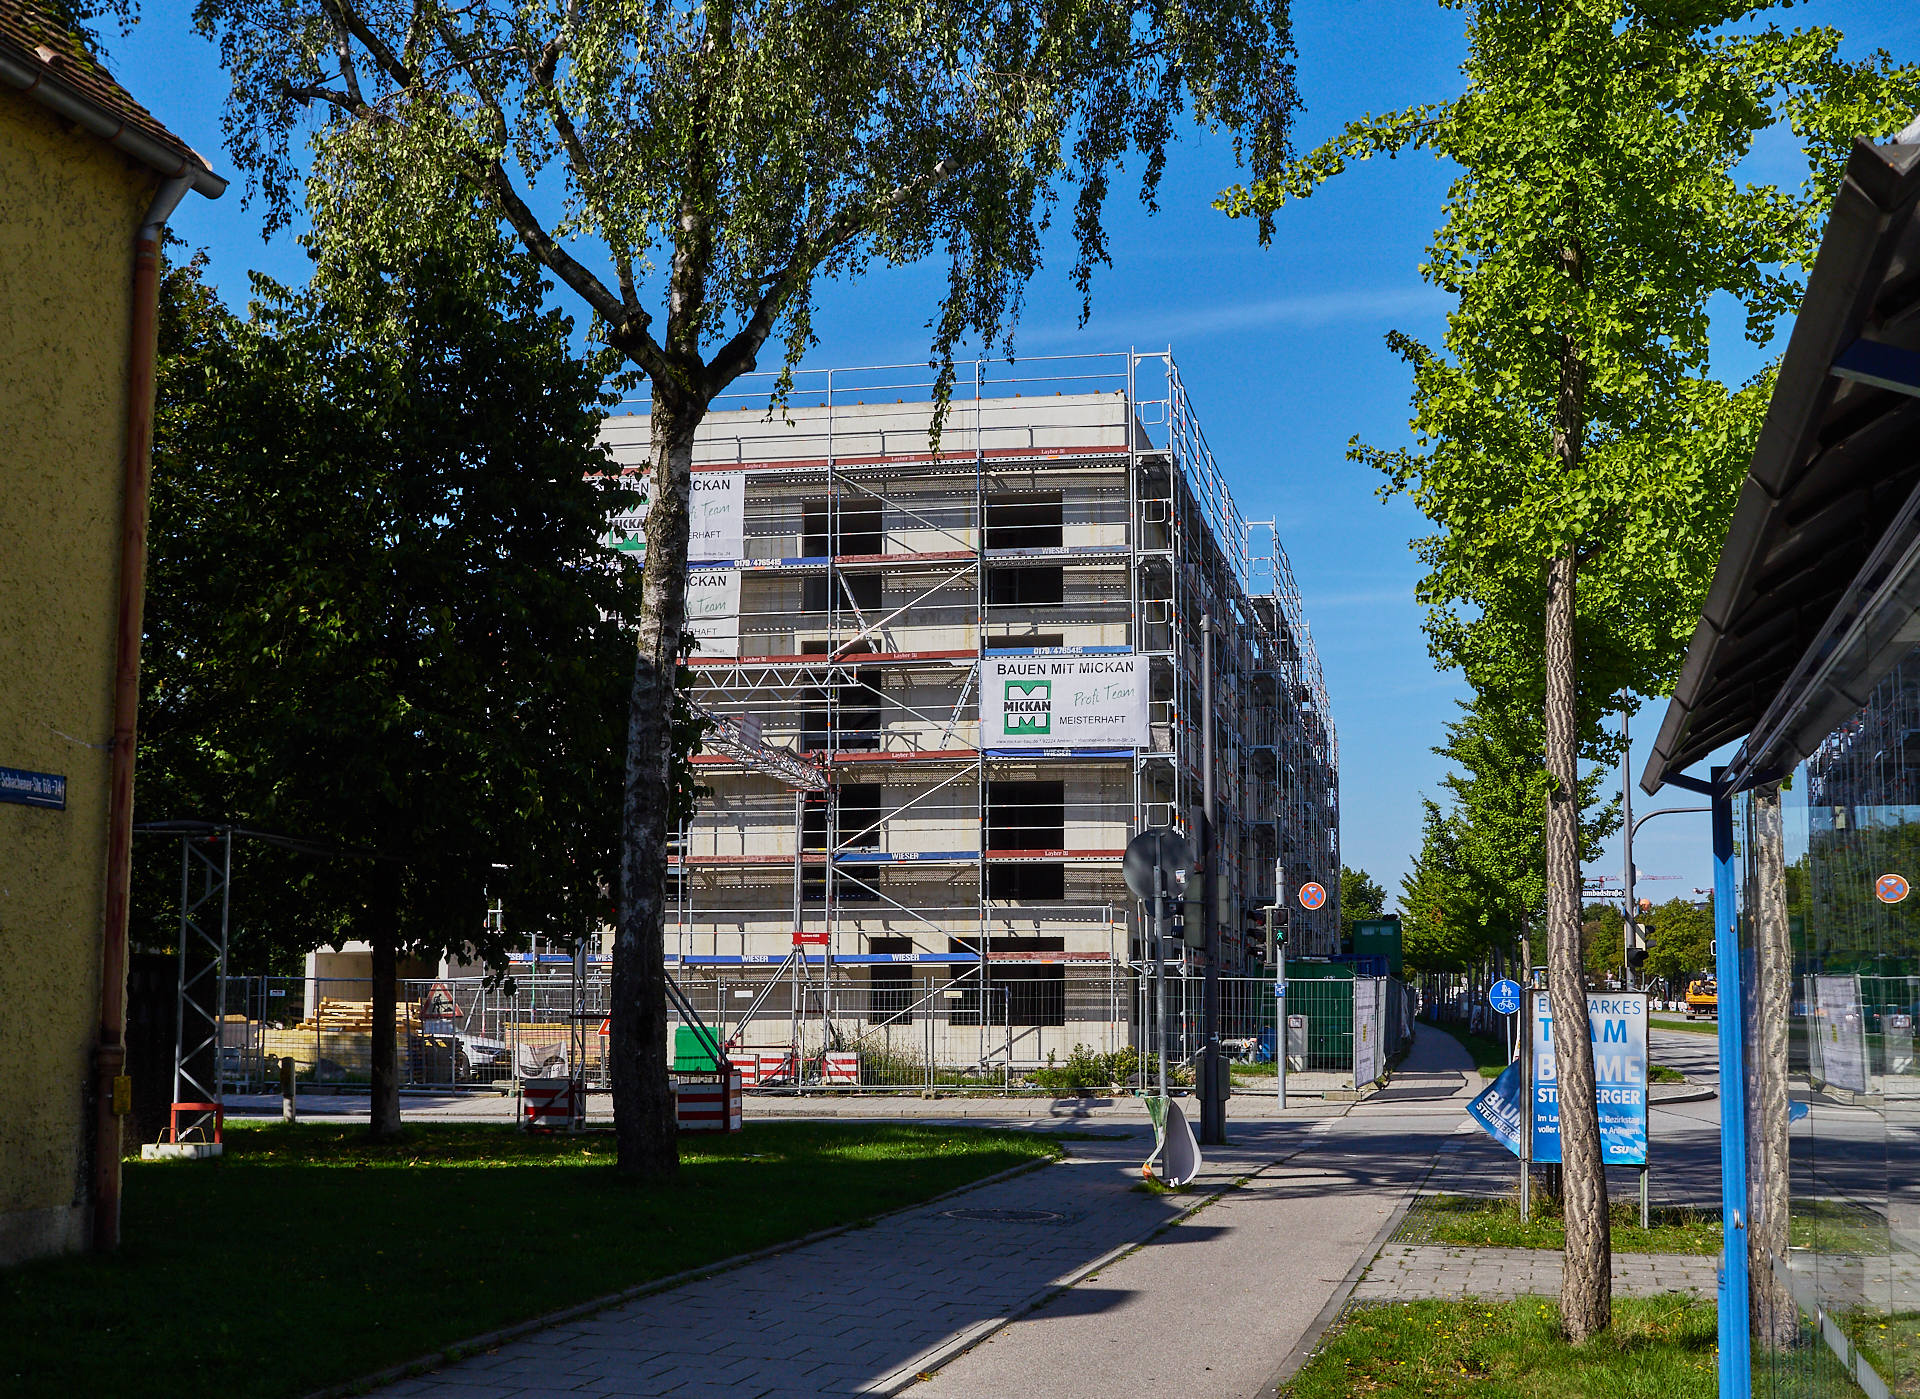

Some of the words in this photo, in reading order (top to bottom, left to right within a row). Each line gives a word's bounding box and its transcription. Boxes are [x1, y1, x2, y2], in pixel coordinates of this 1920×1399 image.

[689, 479, 731, 491] ICKAN
[701, 500, 730, 518] Team
[689, 530, 722, 540] ERHAFT
[1041, 546, 1070, 554] WIESER
[689, 575, 727, 587] CKAN
[697, 596, 727, 613] Team
[997, 663, 1046, 675] BAUEN
[1051, 663, 1074, 674] MIT
[1079, 661, 1134, 674] MICKAN
[1074, 689, 1100, 707] Profi
[1104, 683, 1135, 701] Team
[1004, 701, 1050, 712] MICKAN
[1059, 715, 1126, 725] MEISTERHAFT
[891, 852, 919, 860] WIESER
[1582, 889, 1623, 897] umbadstraße
[595, 954, 613, 962] WIES
[741, 955, 769, 963] WIESER
[891, 953, 920, 962] WIESER
[1538, 998, 1551, 1013] EI
[1587, 999, 1641, 1015] ARKES
[1538, 1017, 1627, 1043] TAM
[1538, 1053, 1641, 1083] BME
[1537, 1087, 1641, 1104] STERGER
[1484, 1090, 1521, 1130] BLUM
[1476, 1102, 1521, 1145] STEINBERGE
[1537, 1114, 1547, 1122] Im
[1604, 1115, 1640, 1125] Bezirkstag
[1537, 1125, 1556, 1134] voller
[1608, 1126, 1640, 1136] Anliegen.
[1610, 1145, 1630, 1154] CSU
